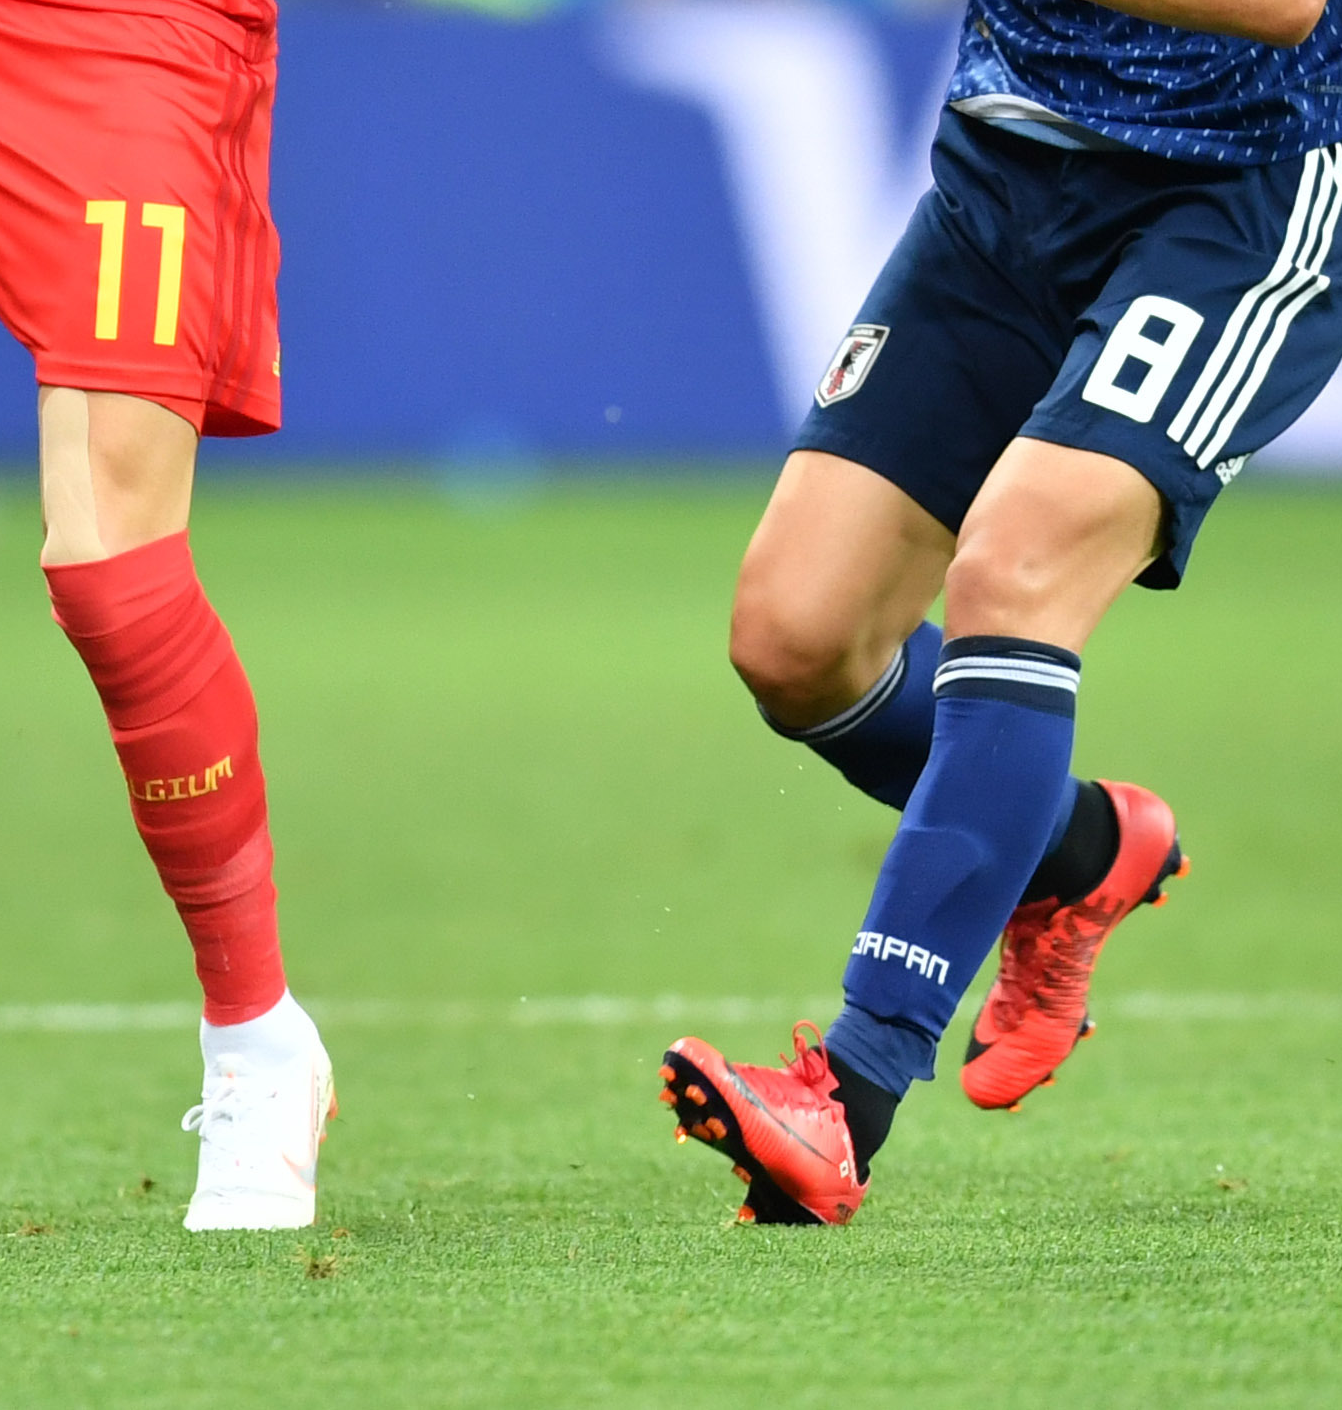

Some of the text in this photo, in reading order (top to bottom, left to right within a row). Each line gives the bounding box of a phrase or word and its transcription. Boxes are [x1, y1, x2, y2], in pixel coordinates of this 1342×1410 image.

[85, 200, 185, 346] 11
[1081, 294, 1205, 423] 8
[851, 931, 950, 986] JAPAN
